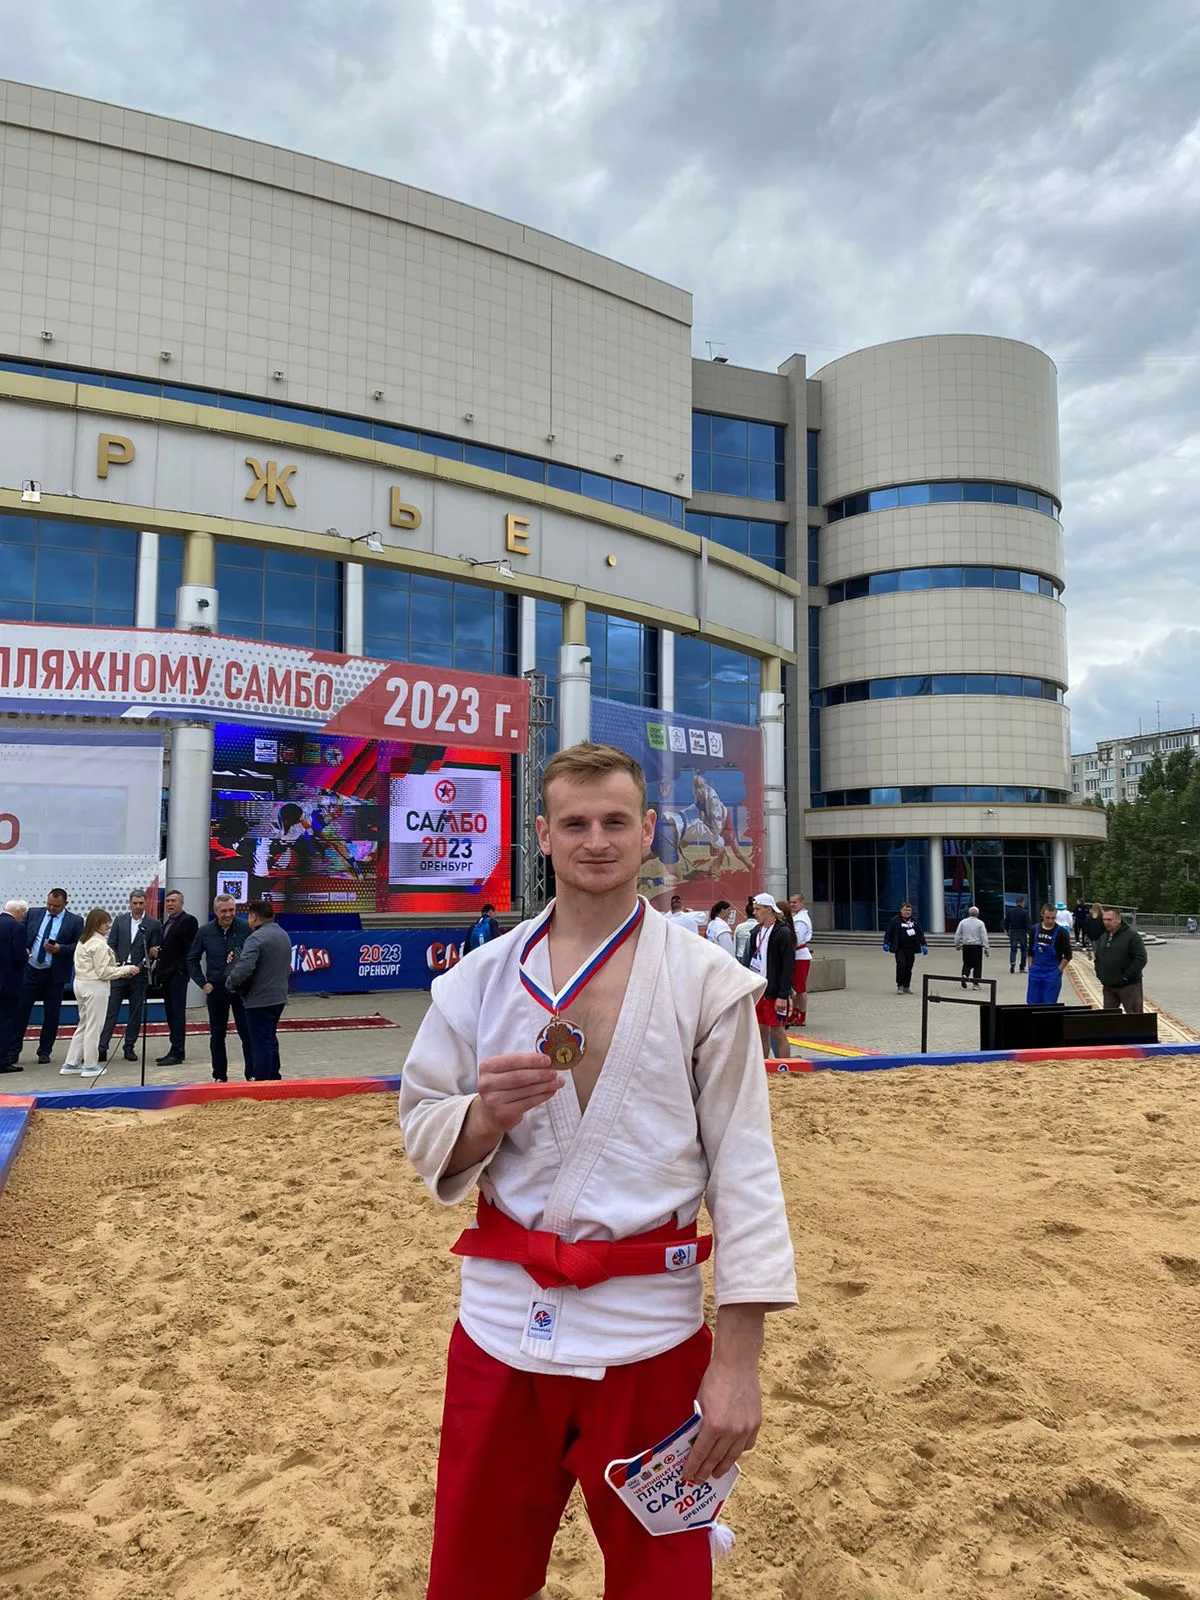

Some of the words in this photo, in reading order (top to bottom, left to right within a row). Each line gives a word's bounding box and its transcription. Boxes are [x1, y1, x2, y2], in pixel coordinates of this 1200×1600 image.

[224, 660, 334, 711] САМБО
[383, 676, 480, 735] 2023
[494, 703, 519, 738] г.
[406, 809, 487, 834] САМБО
[422, 836, 472, 858] 2023
[420, 861, 473, 871] ОРЕНБУРГ
[359, 944, 401, 963] 2023
[358, 964, 401, 977] ОРЕНБУРГ
[633, 1467, 672, 1495] ЧЕМПИОНАТ
[674, 1481, 713, 1515] 2023
[683, 1493, 718, 1522] ОРЕНБУРГ
